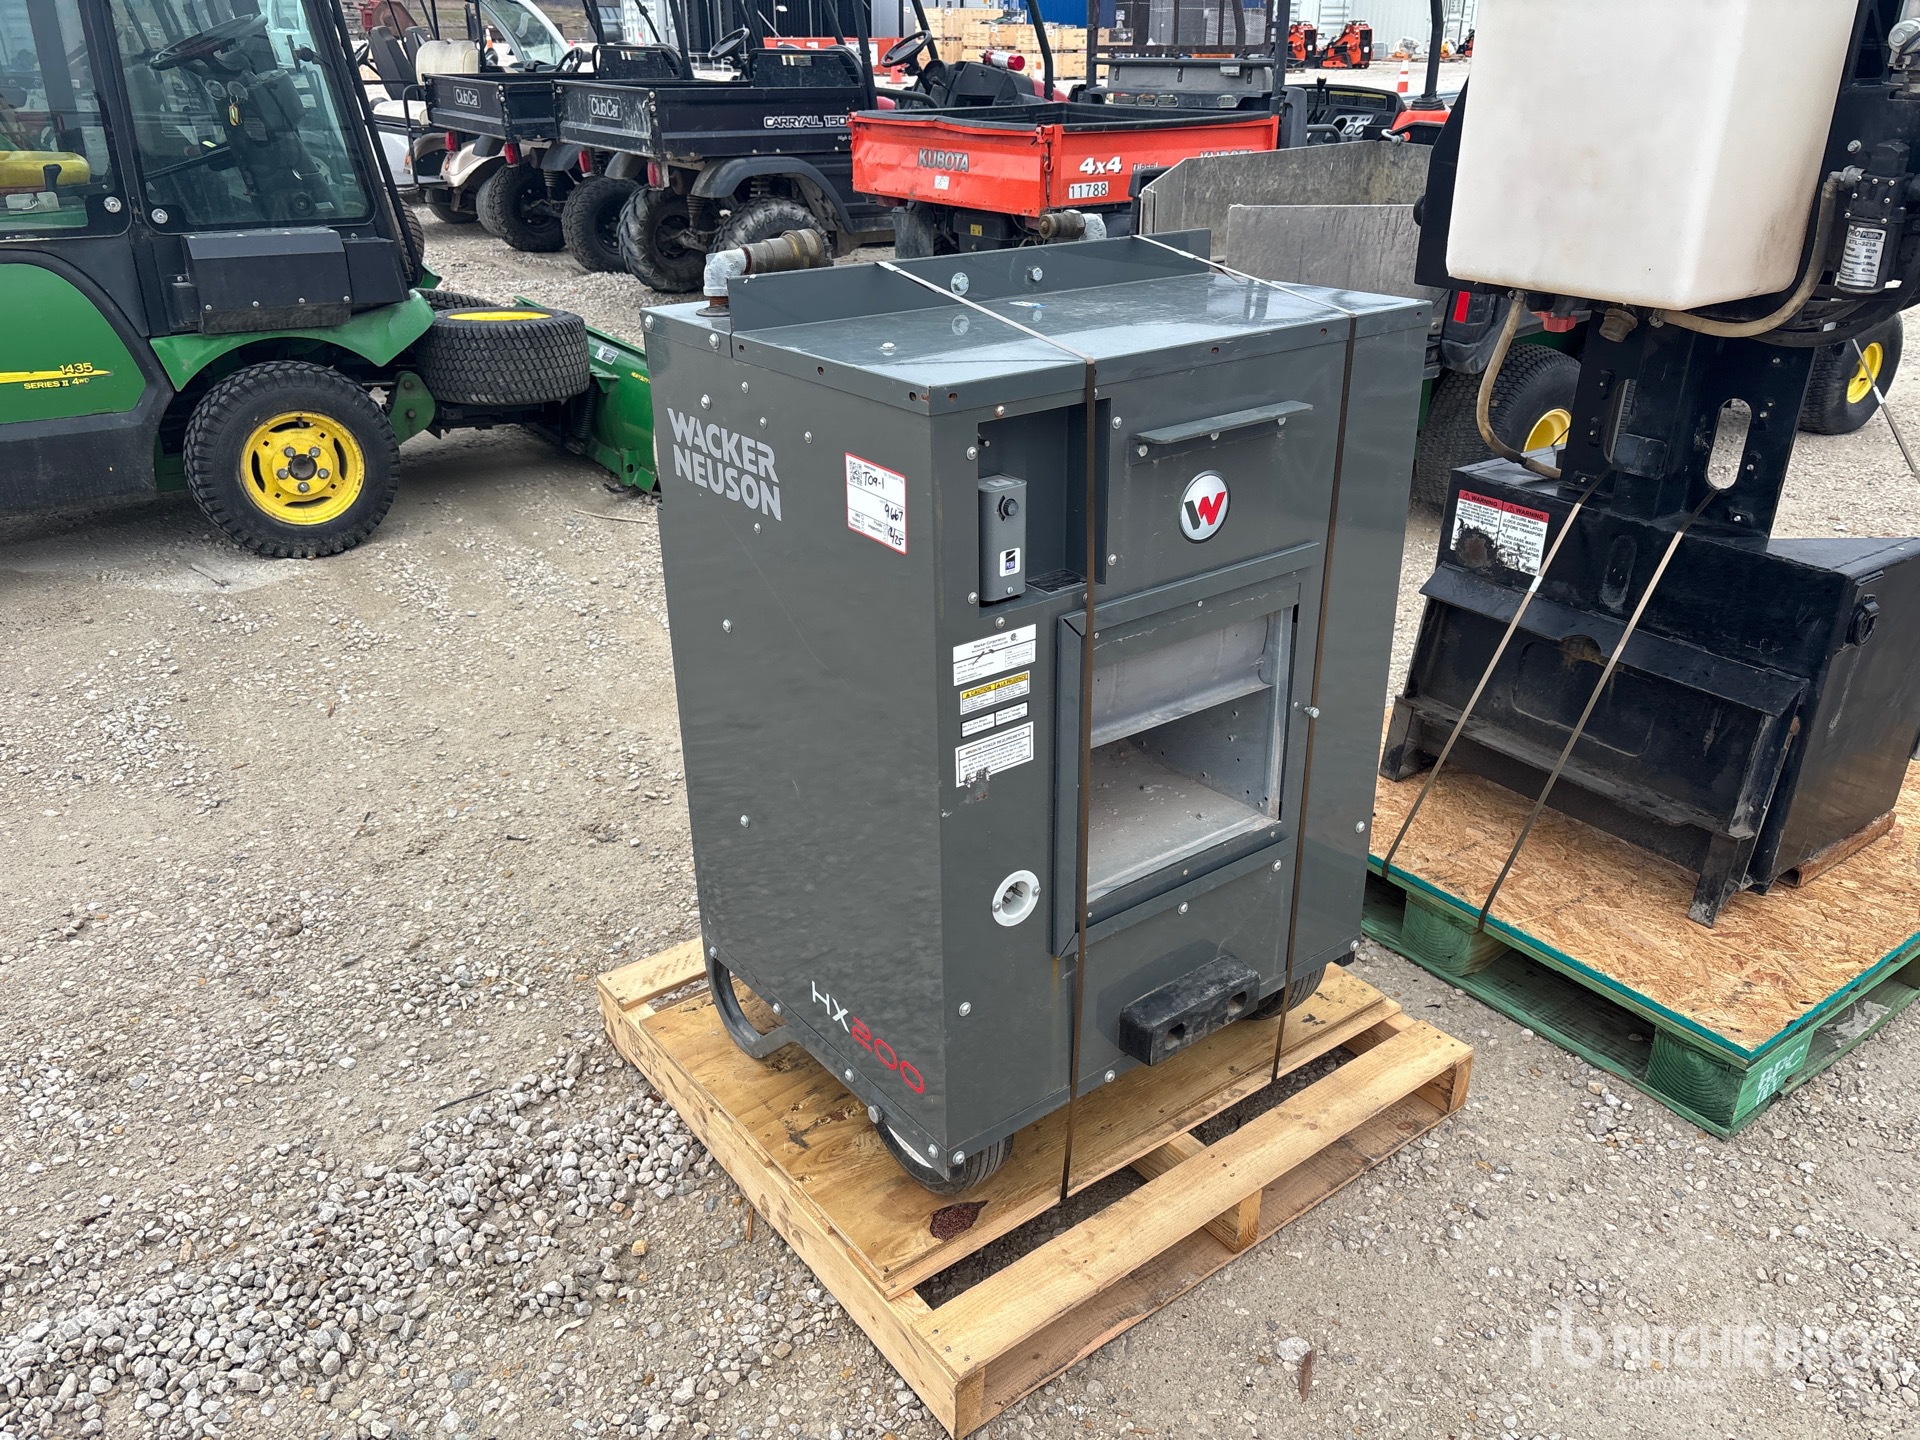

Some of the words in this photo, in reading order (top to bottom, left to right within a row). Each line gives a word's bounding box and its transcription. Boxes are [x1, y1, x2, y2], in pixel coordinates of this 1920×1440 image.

[455, 88, 468, 104] Club
[467, 90, 478, 106] Car
[591, 97, 607, 116] Club
[606, 99, 619, 118] Car
[763, 115, 823, 128] CARRYALL
[823, 114, 850, 127] 150
[917, 148, 969, 172] KUBOTA
[1079, 156, 1122, 174] 4x4
[1070, 182, 1107, 198] 11788
[59, 362, 93, 374] 1435
[23, 380, 60, 389] SERIES
[61, 379, 70, 387] II
[667, 407, 780, 484] WACKER
[673, 444, 782, 521] NEUSON
[1471, 495, 1498, 507] WARNING
[1511, 515, 1526, 523] SECURE
[1515, 508, 1544, 520] WARNING
[811, 980, 925, 1095] HX200
